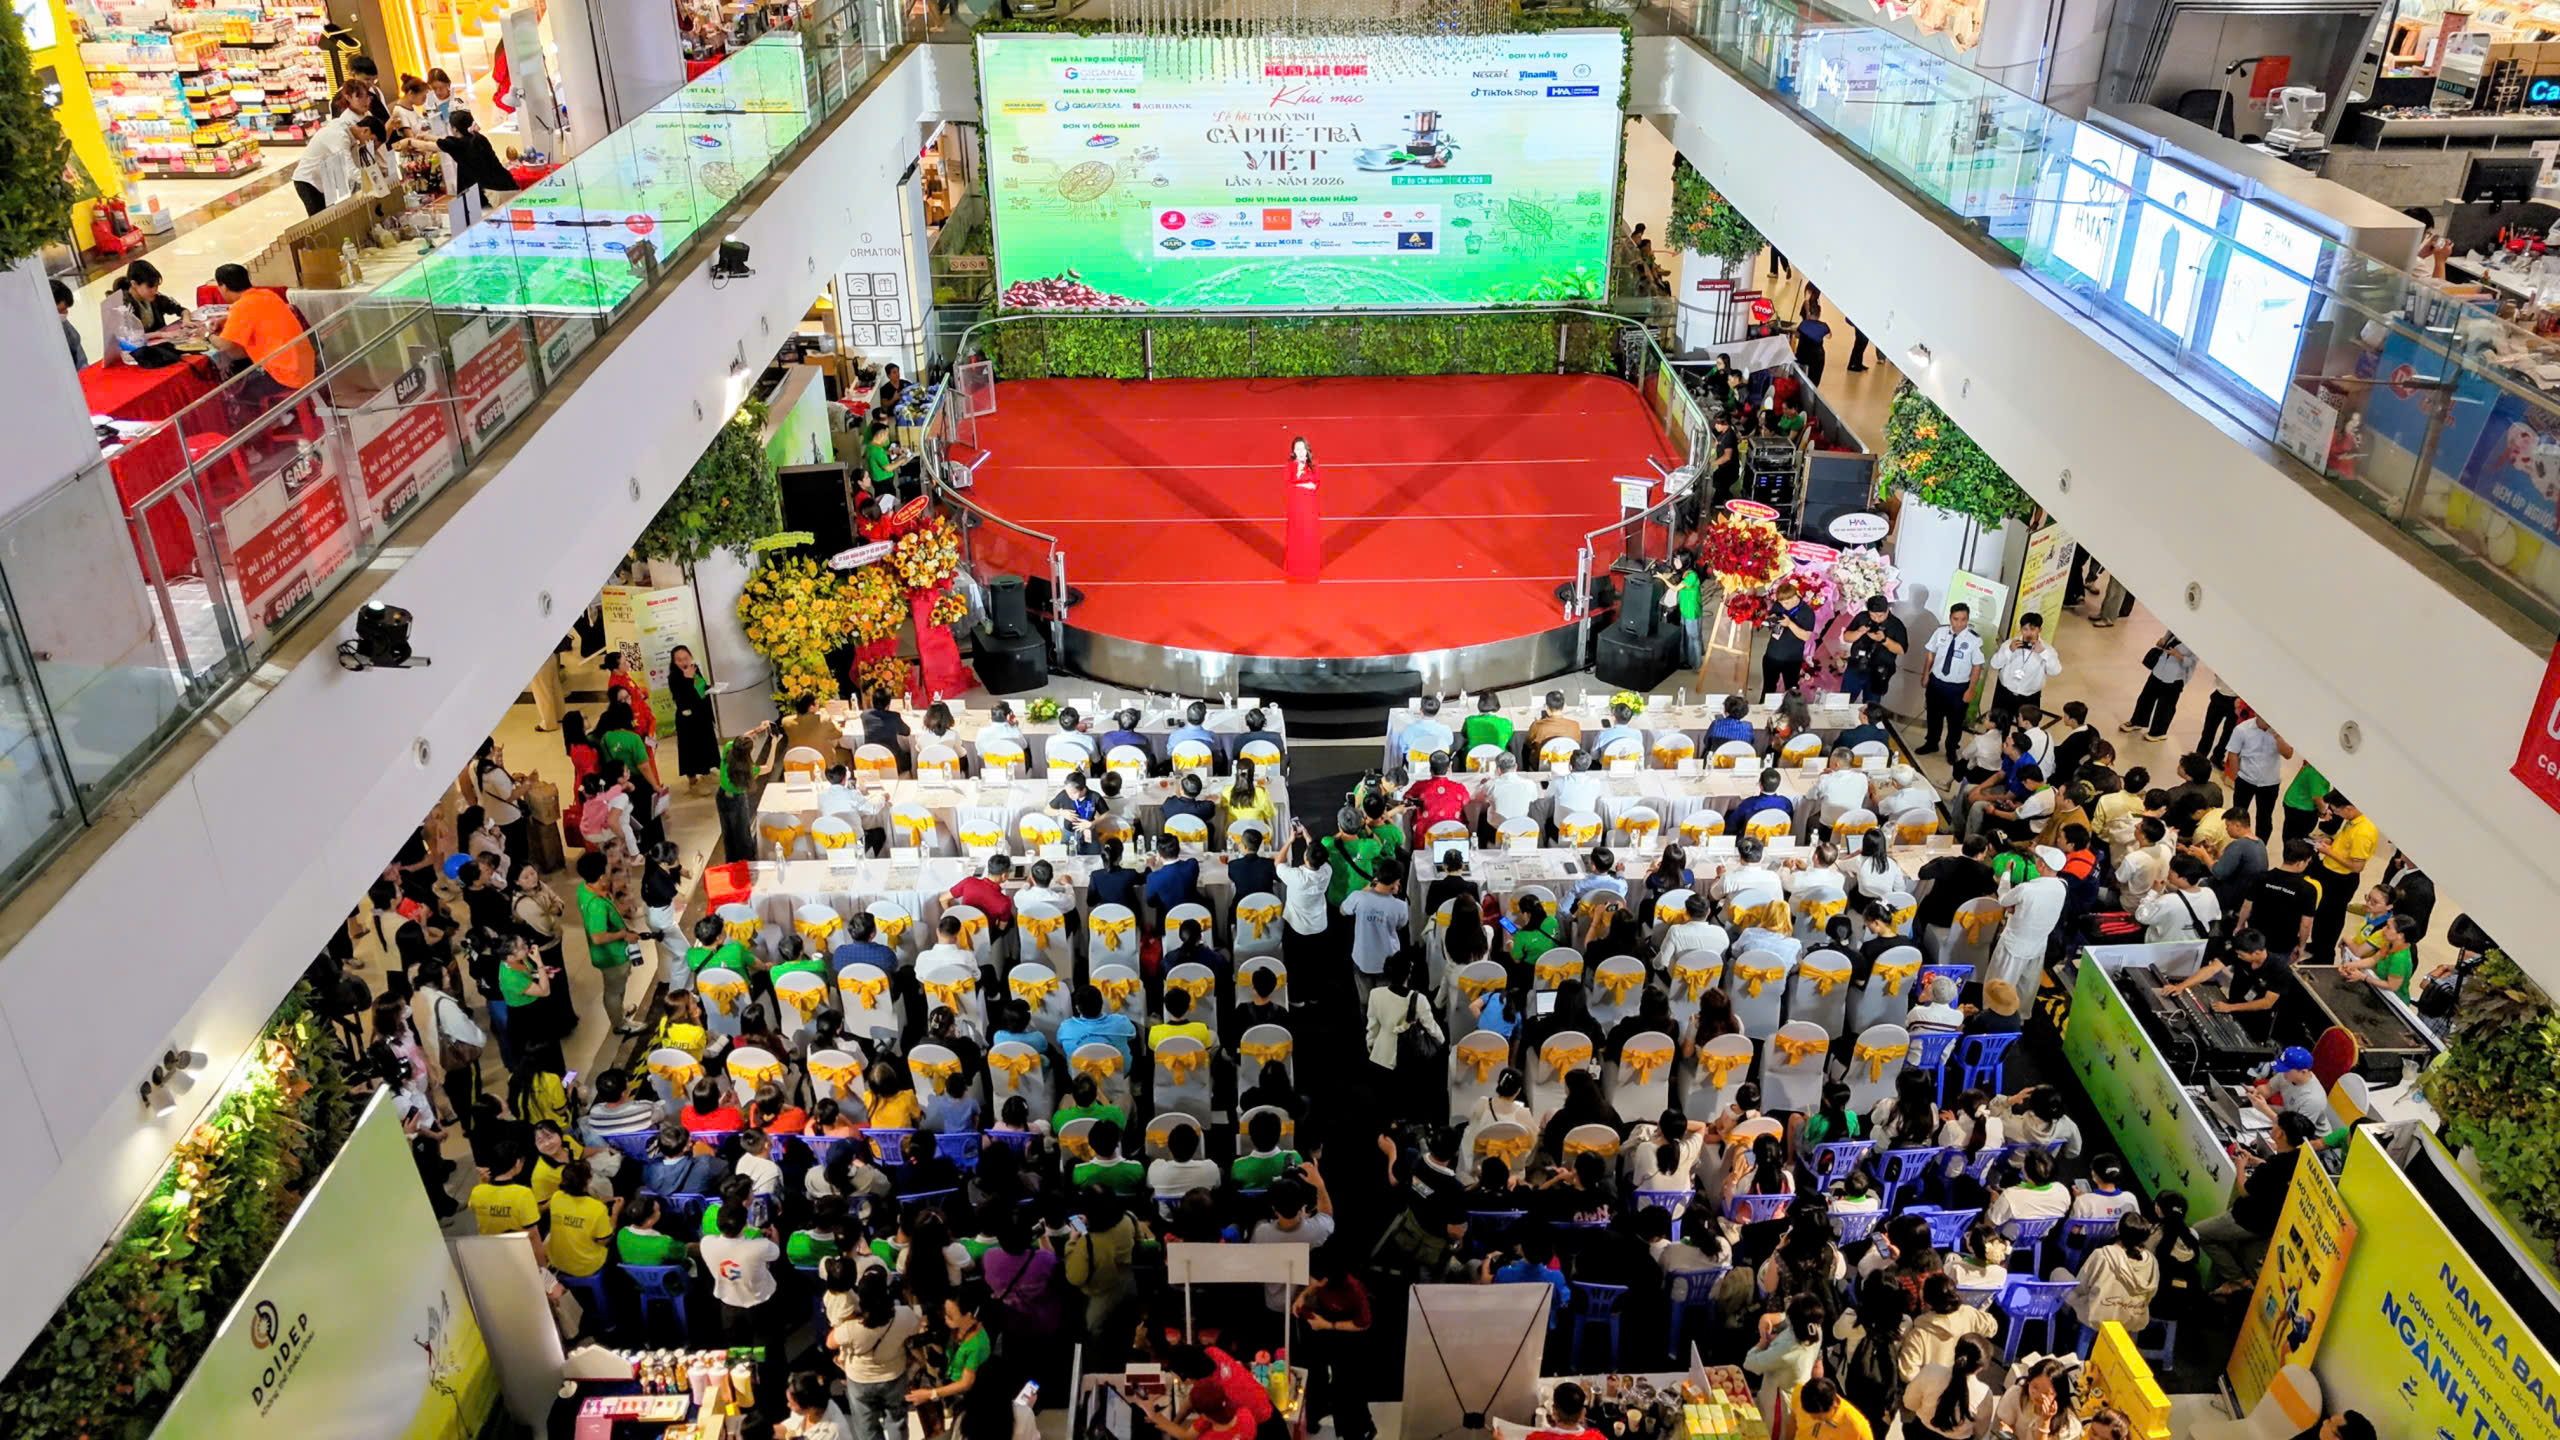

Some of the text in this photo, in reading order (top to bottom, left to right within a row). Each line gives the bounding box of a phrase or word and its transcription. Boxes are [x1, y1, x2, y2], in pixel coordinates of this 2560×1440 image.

[1080, 66, 1135, 77] GIGAMALL
[1519, 70, 1558, 80] Vinamilk
[1483, 88, 1538, 97] TikTok Shop
[1206, 124, 1240, 143] CÀ
[1242, 144, 1328, 175] VIỆT
[1277, 176, 1307, 186] NĂM
[1312, 177, 1345, 186] 2026
[1754, 305, 1772, 314] STOP
[397, 372, 419, 401] SALE
[480, 400, 504, 430] SUPER
[284, 460, 313, 488] SALE
[389, 479, 418, 514] SUPER
[275, 576, 311, 619] SUPER
[2282, 887, 2296, 896] TEAM
[2439, 1262, 2493, 1336] NAM
[2492, 1334, 2508, 1361] A
[252, 1313, 308, 1406] DOIDEP
[2381, 1290, 2469, 1417] NGÀNH
[2465, 1367, 2494, 1404] PHÁT
